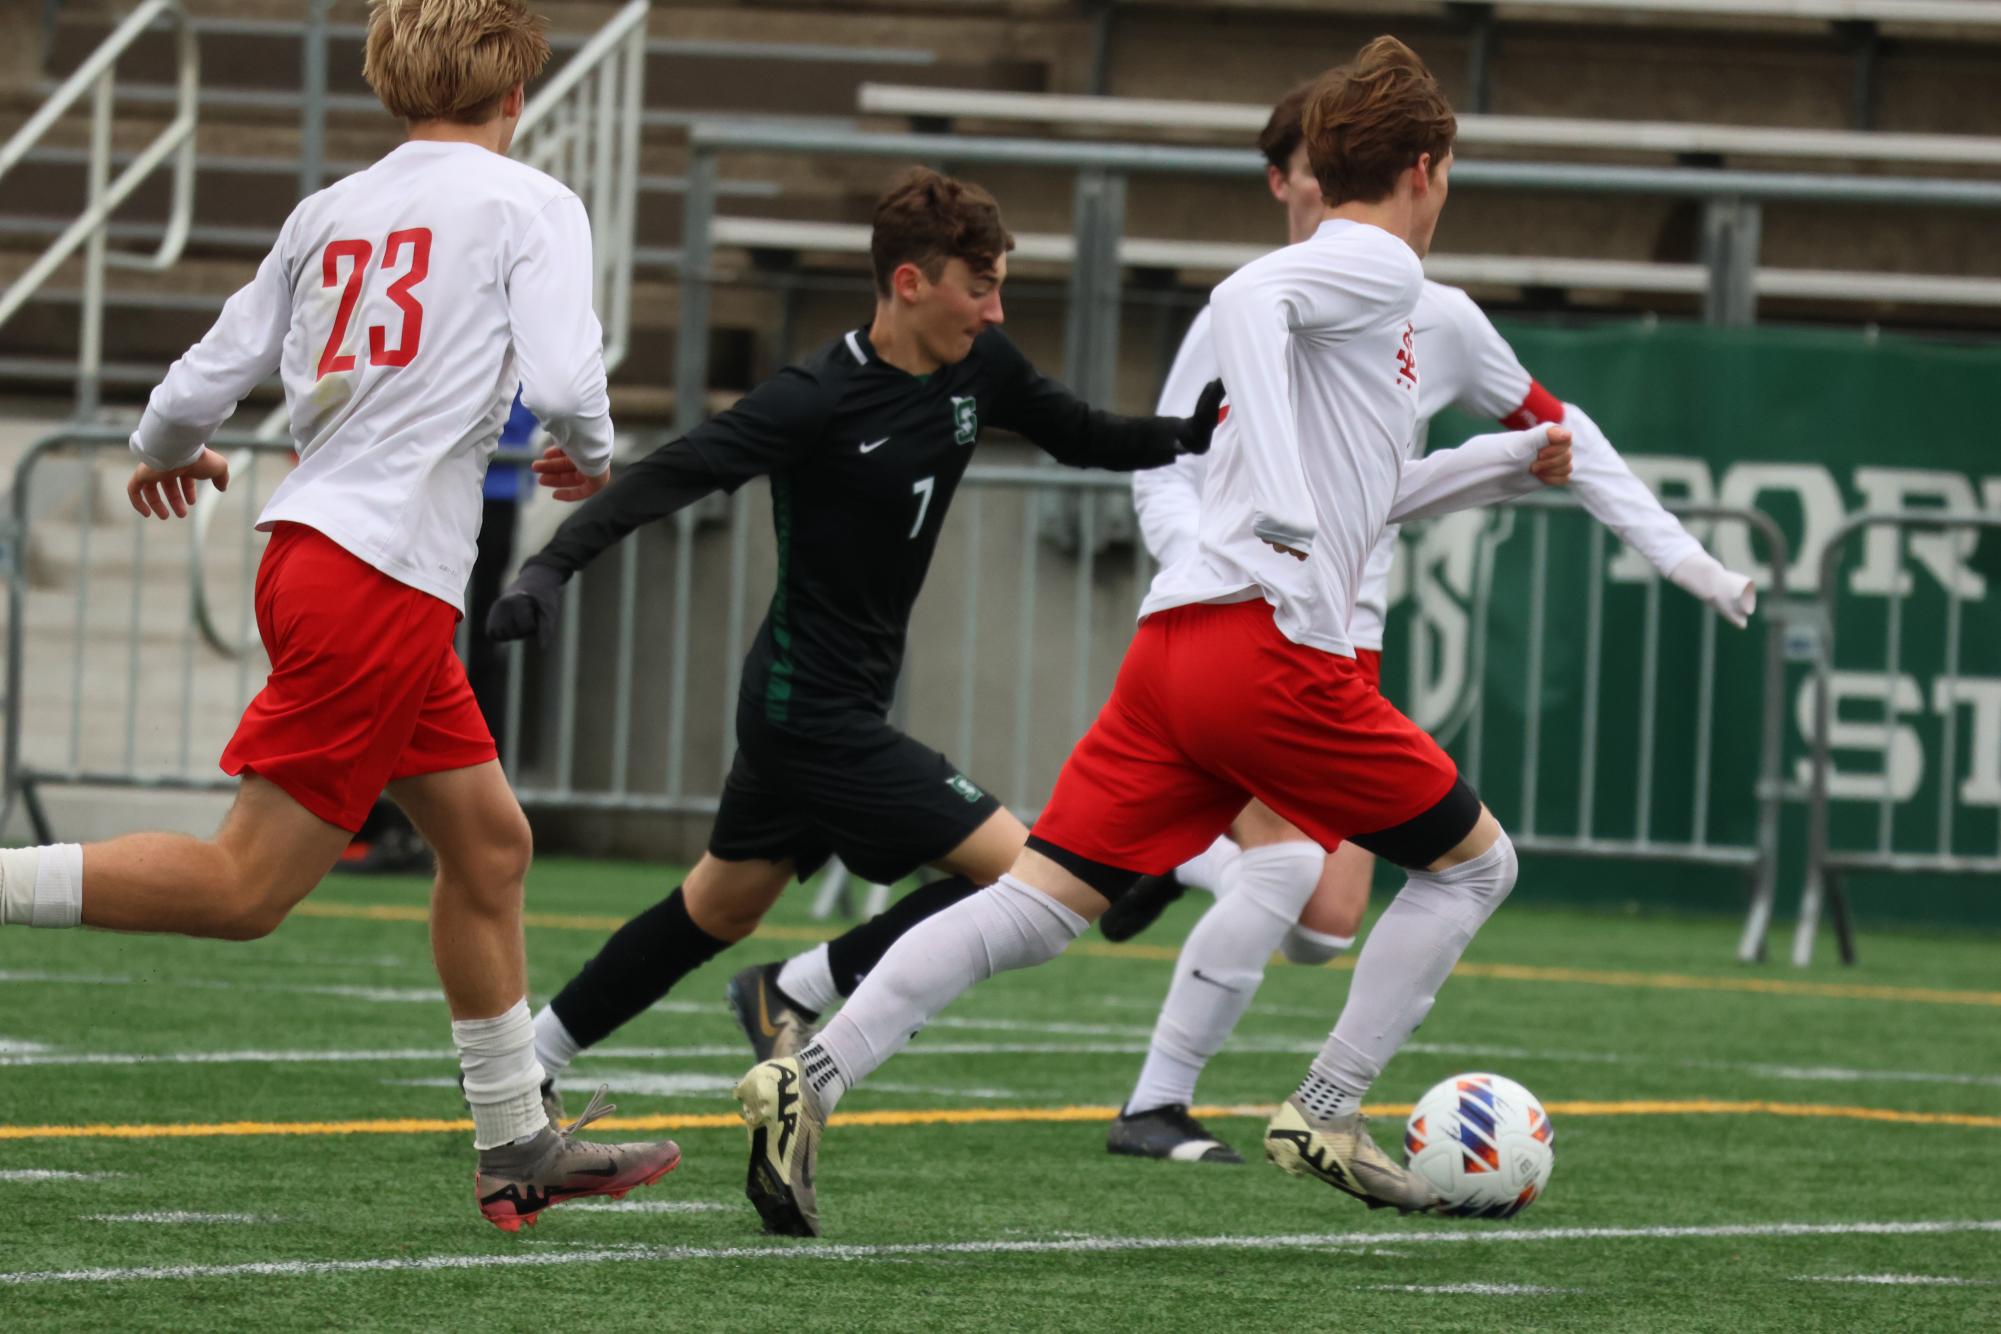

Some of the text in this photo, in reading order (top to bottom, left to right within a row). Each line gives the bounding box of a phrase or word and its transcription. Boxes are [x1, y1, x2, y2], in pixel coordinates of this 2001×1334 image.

[317, 227, 433, 384] 23
[908, 475, 935, 540] 7
[1609, 453, 2001, 601] POR
